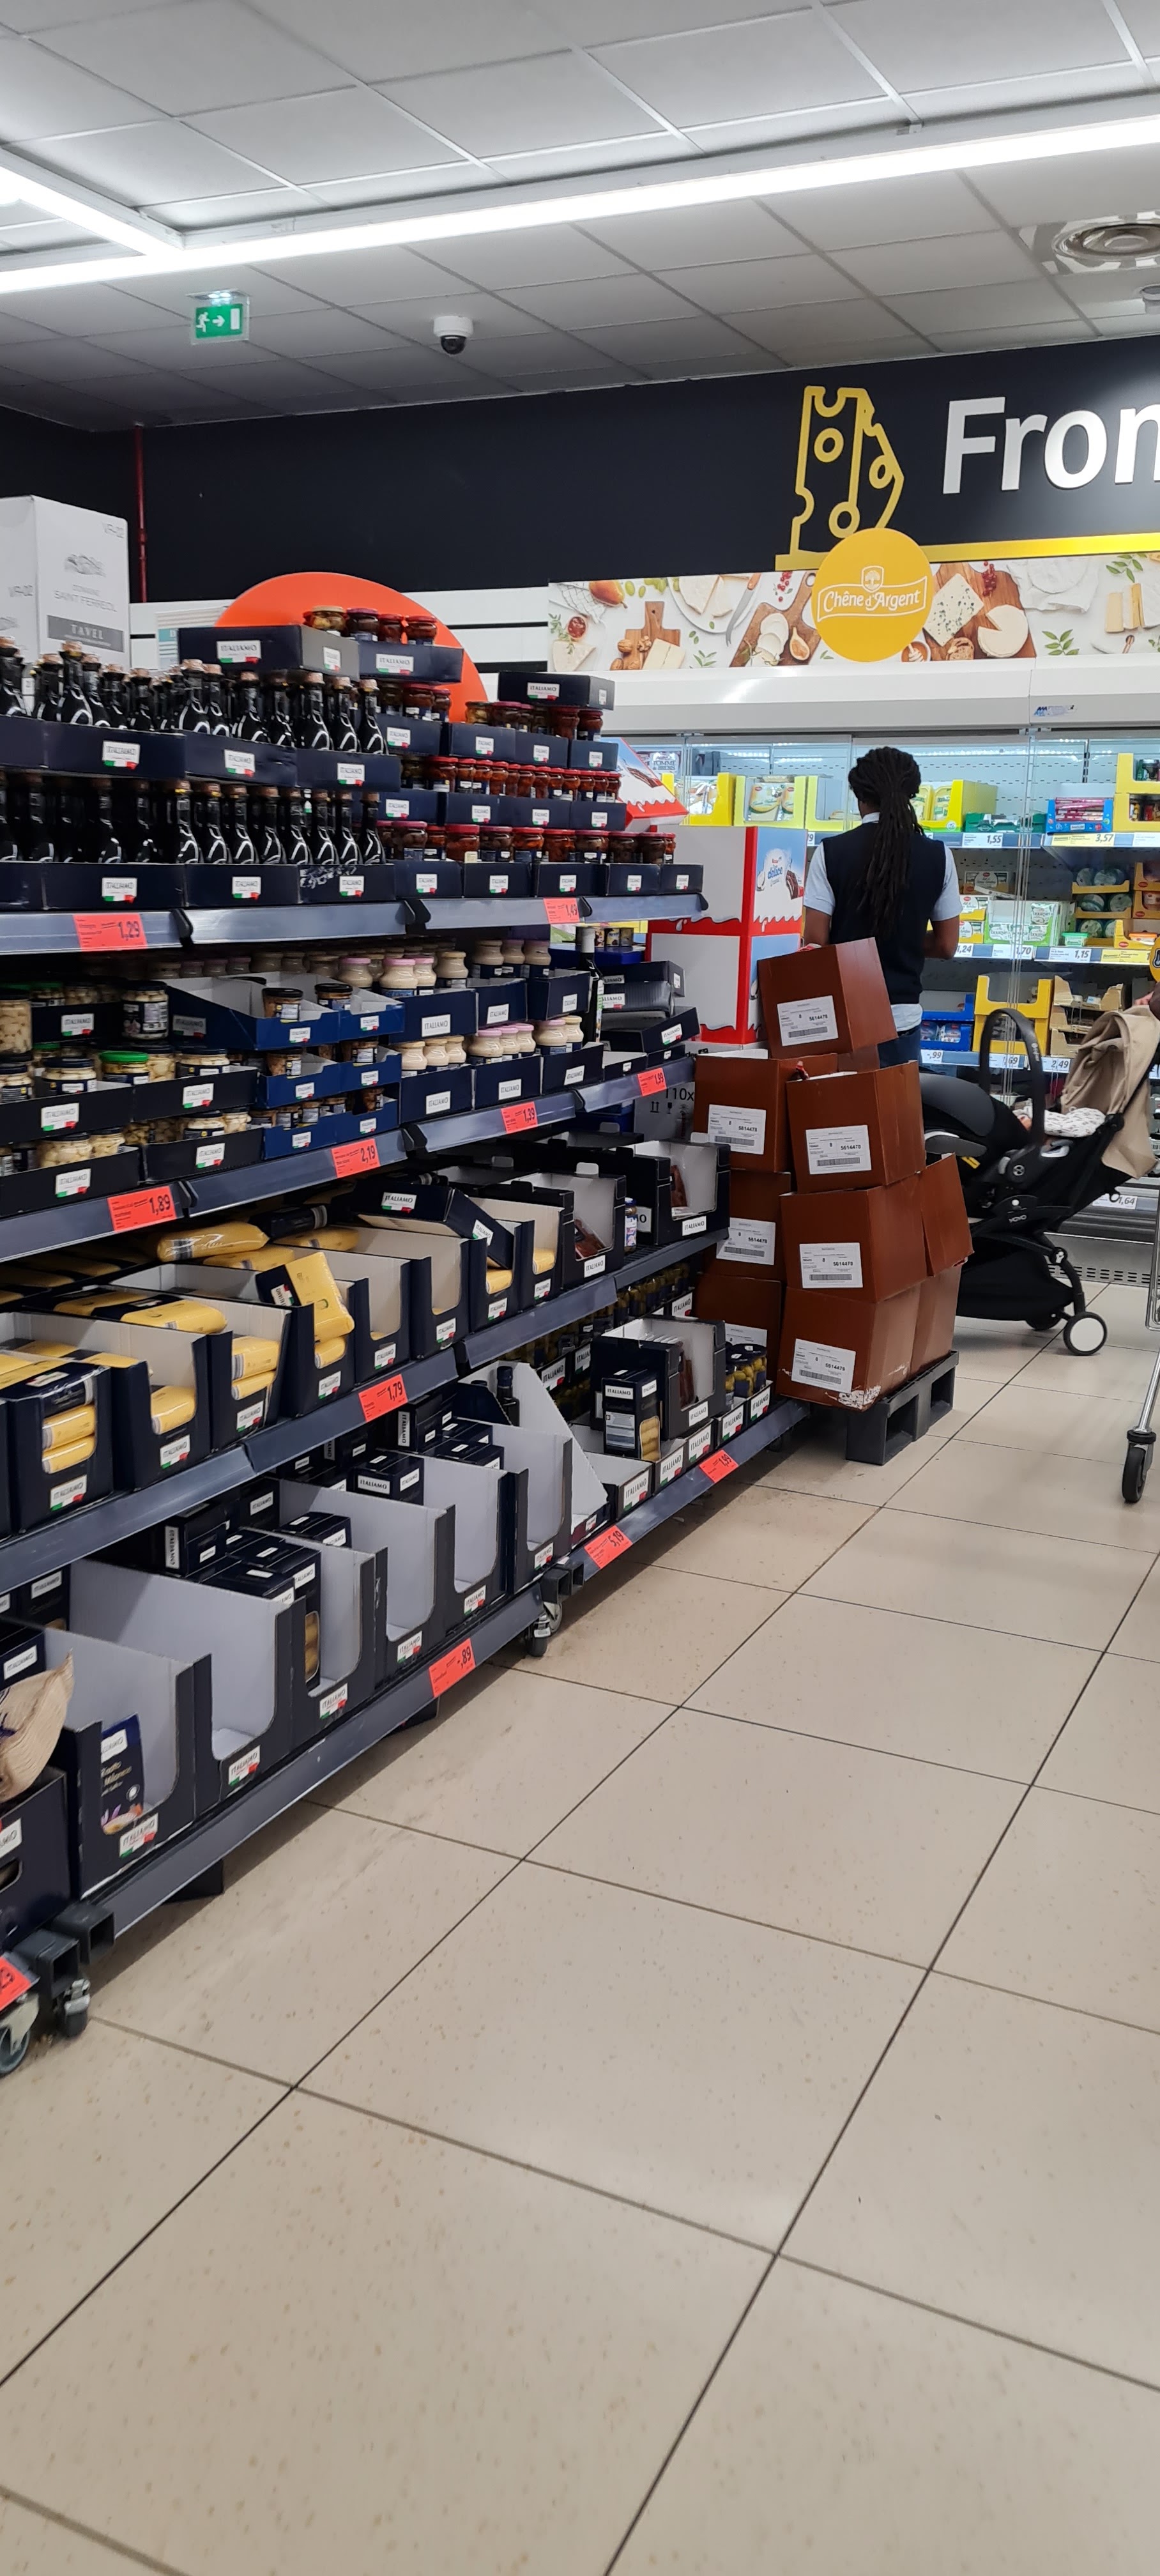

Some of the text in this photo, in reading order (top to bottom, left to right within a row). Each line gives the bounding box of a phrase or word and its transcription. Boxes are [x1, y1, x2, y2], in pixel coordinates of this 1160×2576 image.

[823, 589, 921, 613] Chêne d'Argent
[71, 624, 103, 640] TAVEL
[986, 835, 1002, 845] 1,55
[1095, 834, 1114, 843] 3,57
[565, 903, 578, 918] 1,49
[118, 921, 140, 941] 1,29
[1016, 947, 1032, 955] 1,70
[1074, 949, 1089, 959] 1,15
[425, 1020, 448, 1030] ITALIAMO
[927, 1051, 942, 1060] -,99
[1051, 1061, 1069, 1070] 2,49
[654, 1073, 664, 1085] 1,99
[429, 1098, 448, 1108] ITALIAMO
[523, 1107, 535, 1123] 1,39
[360, 1145, 376, 1162] 2,19
[149, 1194, 171, 1215] 1,89
[384, 1194, 413, 1203] ITALIAMO
[684, 1221, 705, 1230] ITALIAMO
[586, 1259, 604, 1272] ITALIAMO
[673, 1298, 691, 1313] ITALIAMO
[577, 1350, 591, 1363] ITALIA
[543, 1364, 564, 1382] ITALIAMO
[387, 1381, 403, 1401] 1,79
[607, 1388, 631, 1396] ITALIAMO
[752, 1394, 769, 1411] ITALIAMO
[691, 1407, 706, 1420] ITALIAMO
[724, 1413, 742, 1429] ITALIAMO
[691, 1432, 709, 1451] ITALIAMO
[662, 1455, 682, 1475] ITALIAMO
[360, 1479, 387, 1490] ITALIAMO
[626, 1478, 646, 1498] ITALIAMO
[608, 1530, 625, 1548] 5,19
[295, 1569, 314, 1583] TALIAMO
[466, 1590, 484, 1606] ITALIAMO
[399, 1636, 420, 1653] ITALIAMO
[457, 1646, 471, 1668] -,89
[321, 1689, 346, 1709] ITALIAMO
[231, 1751, 257, 1776] ITALIAMO
[123, 1818, 155, 1846] ITALIAMO
